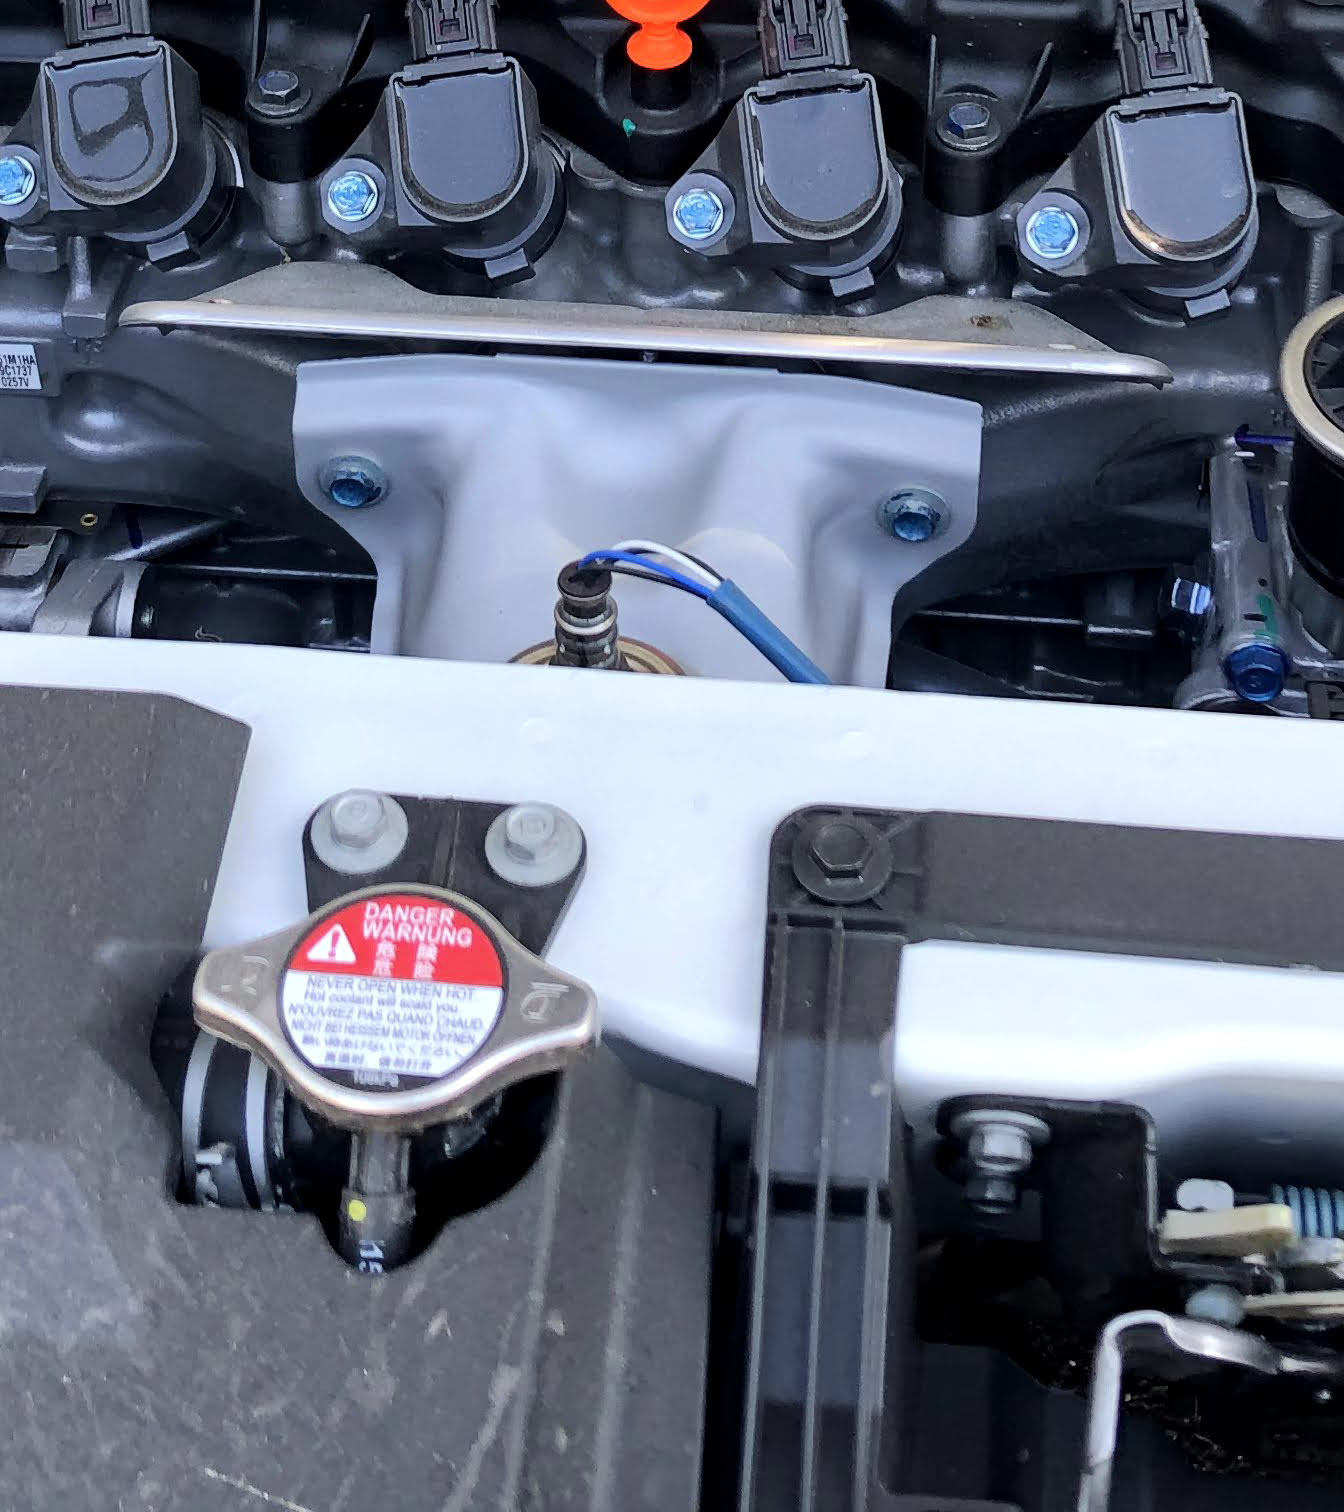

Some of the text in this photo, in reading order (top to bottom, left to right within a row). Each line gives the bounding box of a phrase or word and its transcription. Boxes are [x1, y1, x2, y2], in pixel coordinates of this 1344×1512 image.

[363, 900, 455, 926] DANGER
[361, 919, 473, 949] WARNUNG
[306, 974, 354, 990] NEVER
[357, 979, 397, 994] OPEN
[400, 982, 444, 999] WHEN
